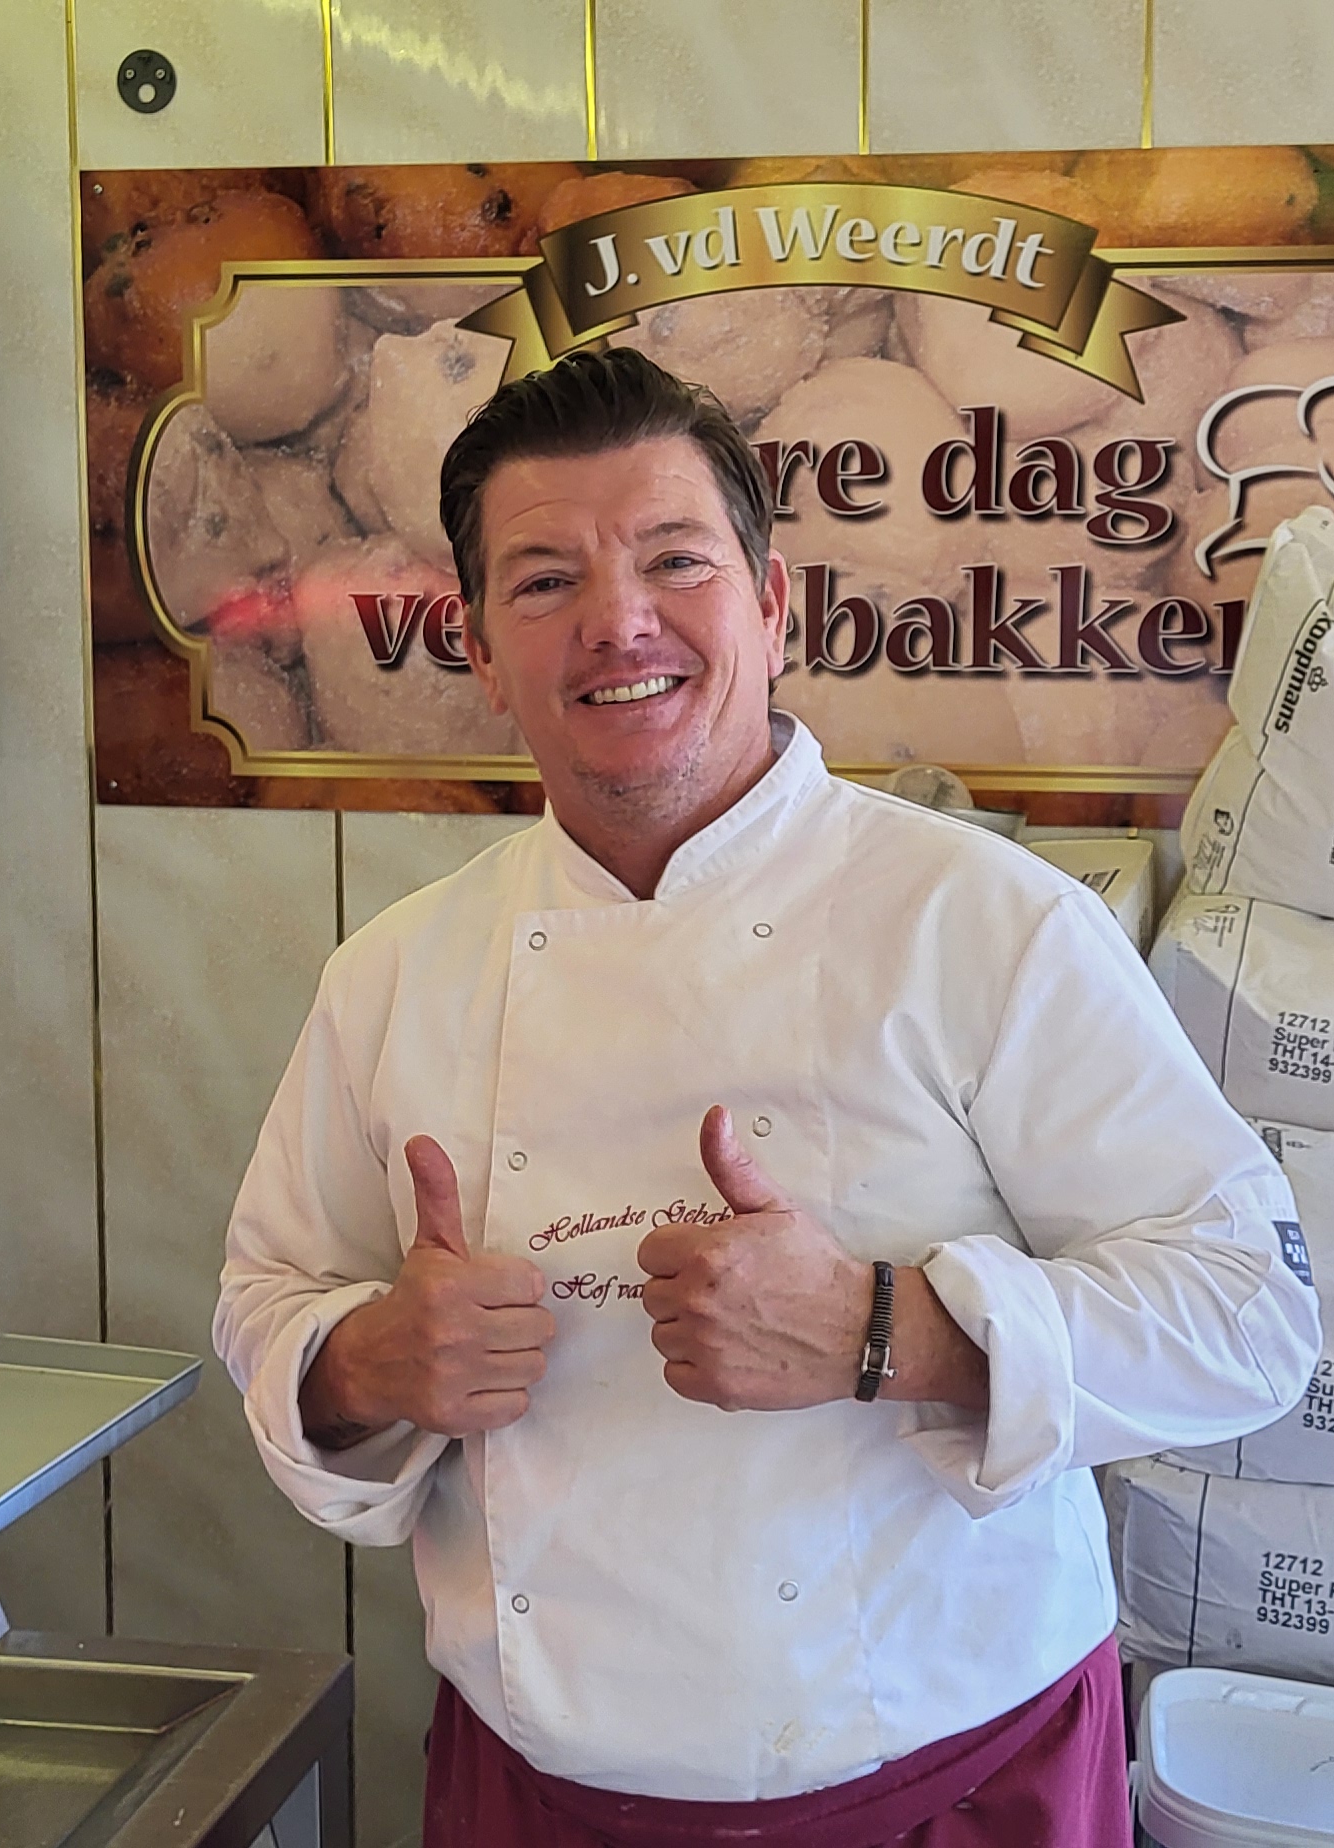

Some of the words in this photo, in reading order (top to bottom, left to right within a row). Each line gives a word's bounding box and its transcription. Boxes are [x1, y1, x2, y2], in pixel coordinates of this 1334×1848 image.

[585, 233, 639, 297] J.
[644, 207, 741, 277] vd
[755, 204, 1056, 289] Weerdt
[752, 436, 886, 516] re
[921, 405, 1176, 544] dag
[786, 562, 1247, 675] bakke
[1277, 1010, 1331, 1034] 12712
[1270, 1041, 1309, 1063] THT
[1273, 1026, 1328, 1052] Super
[1267, 1057, 1332, 1085] 932399
[528, 1204, 648, 1252] Hollandse
[652, 1199, 734, 1228] Gebak
[552, 1272, 619, 1309] Hof
[617, 1282, 646, 1300] va
[1261, 1550, 1324, 1577] 12712
[1259, 1570, 1322, 1597] Super
[1258, 1588, 1301, 1612] THT
[1256, 1606, 1331, 1634] 932399
